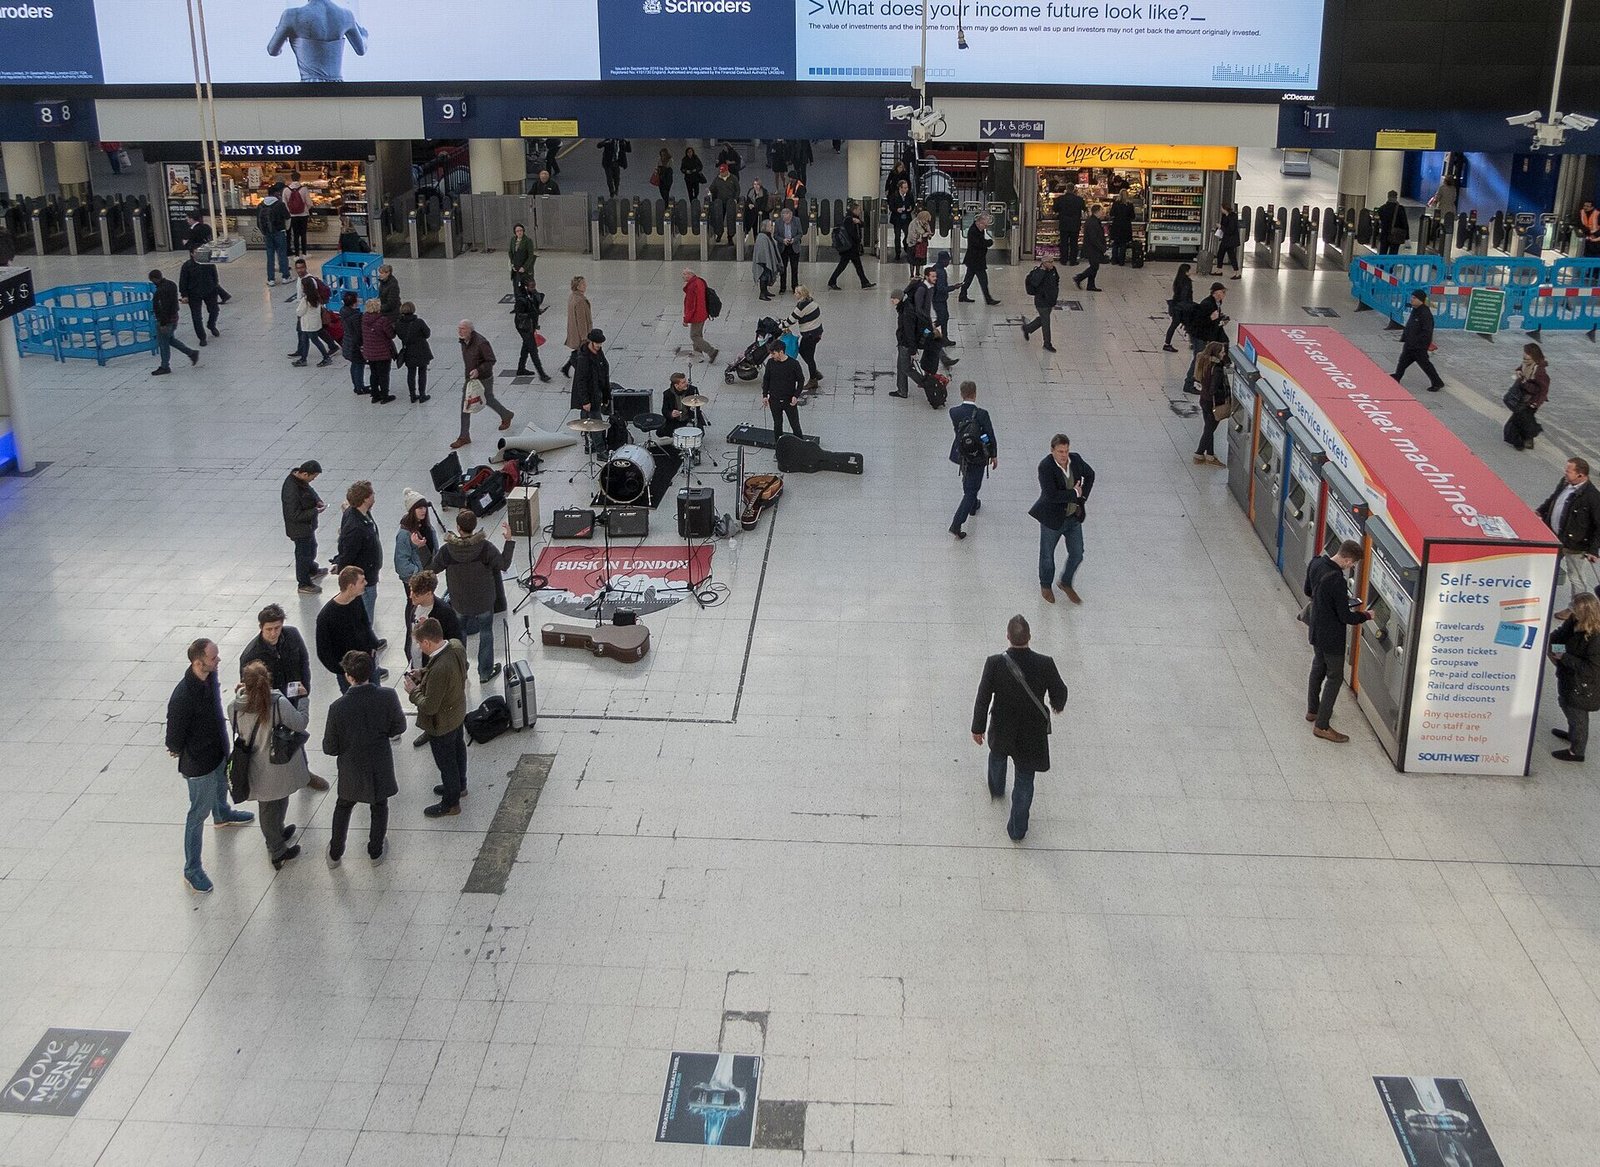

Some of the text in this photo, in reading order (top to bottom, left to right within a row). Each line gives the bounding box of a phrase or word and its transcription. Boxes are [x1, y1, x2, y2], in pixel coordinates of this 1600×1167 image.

[665, 0, 752, 14] Schroders
[880, 0, 923, 17] does
[930, 4, 970, 20] your
[975, 2, 1041, 18] income
[1047, 3, 1099, 19] future
[1104, 4, 1142, 20] look
[1282, 93, 1315, 101] JCDecaux
[41, 107, 53, 123] 8
[62, 105, 71, 120] 8
[443, 103, 455, 119] 9
[461, 102, 468, 117] 9
[1303, 110, 1311, 127] 11
[1315, 112, 1330, 129] 11
[224, 145, 302, 156] PASTY SHOP
[1065, 144, 1138, 164] Upper Crust
[1281, 329, 1357, 390] Self-service
[1347, 393, 1404, 433] ticket
[1389, 437, 1479, 527] machines
[1282, 379, 1321, 436] Self-service
[1323, 429, 1348, 469] tickets
[554, 560, 600, 571] BUSK
[622, 560, 690, 570] LONDON
[1440, 573, 1532, 589] Self-service
[1439, 591, 1490, 604] tickets
[1435, 621, 1485, 631] Travelcards
[1433, 634, 1464, 644] Oyster
[1432, 646, 1498, 656] Season tickets
[1430, 658, 1479, 668] Groupsave
[1428, 669, 1516, 681] Pre-paid collection
[1427, 682, 1510, 692] Railcard discounts
[1426, 693, 1496, 704] Child discounts
[1424, 710, 1492, 721] Any questions?
[1422, 721, 1440, 730] Our
[1443, 720, 1464, 730] staff
[1455, 734, 1465, 742] to
[1468, 734, 1488, 744] help
[1418, 752, 1451, 762] SOUTH
[1452, 754, 1480, 763] WEST
[4, 1040, 63, 1101] Dove
[30, 1061, 70, 1102] MEN
